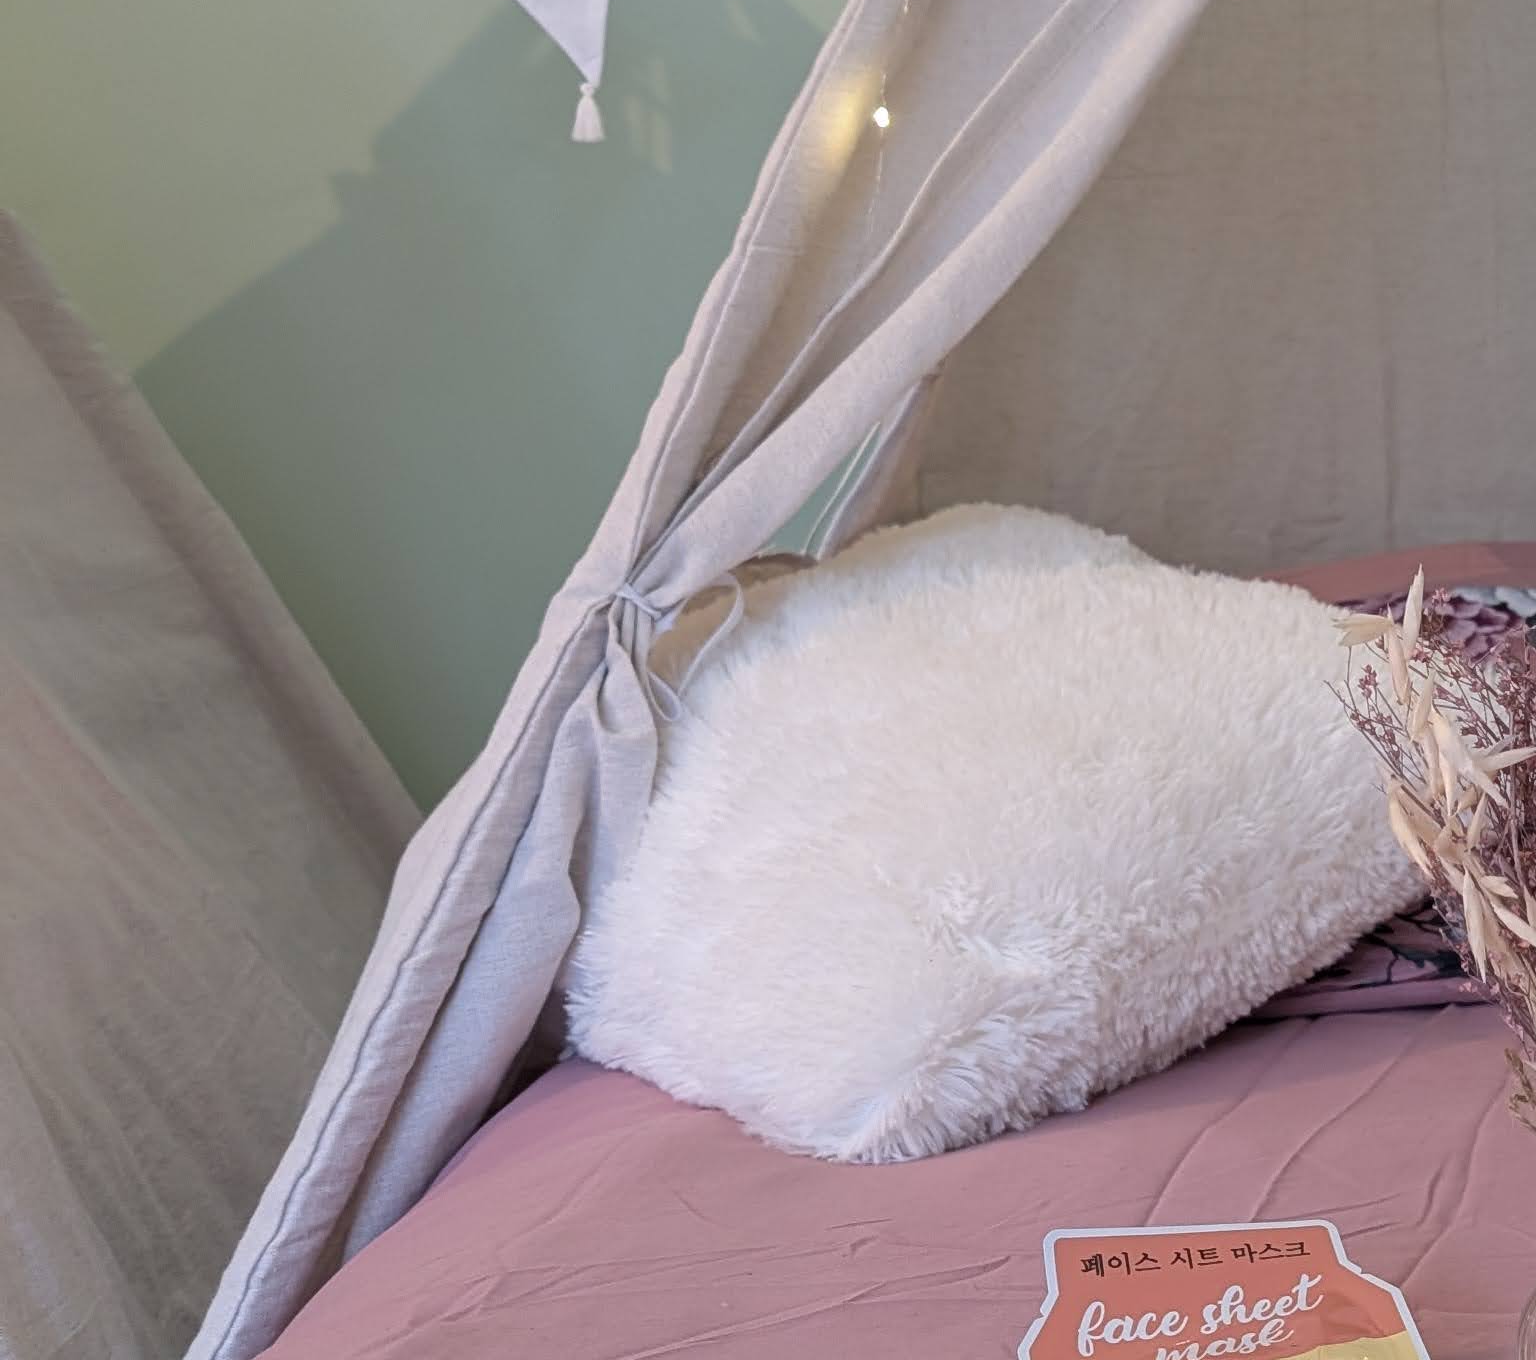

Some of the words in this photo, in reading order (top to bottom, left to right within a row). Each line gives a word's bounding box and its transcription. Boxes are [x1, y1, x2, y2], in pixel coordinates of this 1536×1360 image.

[1080, 1251, 1161, 1277] 페이스
[1170, 1247, 1223, 1269] 시트
[1231, 1241, 1311, 1264] 마스크
[1077, 1301, 1188, 1357] face
[1200, 1273, 1324, 1335] sheet
